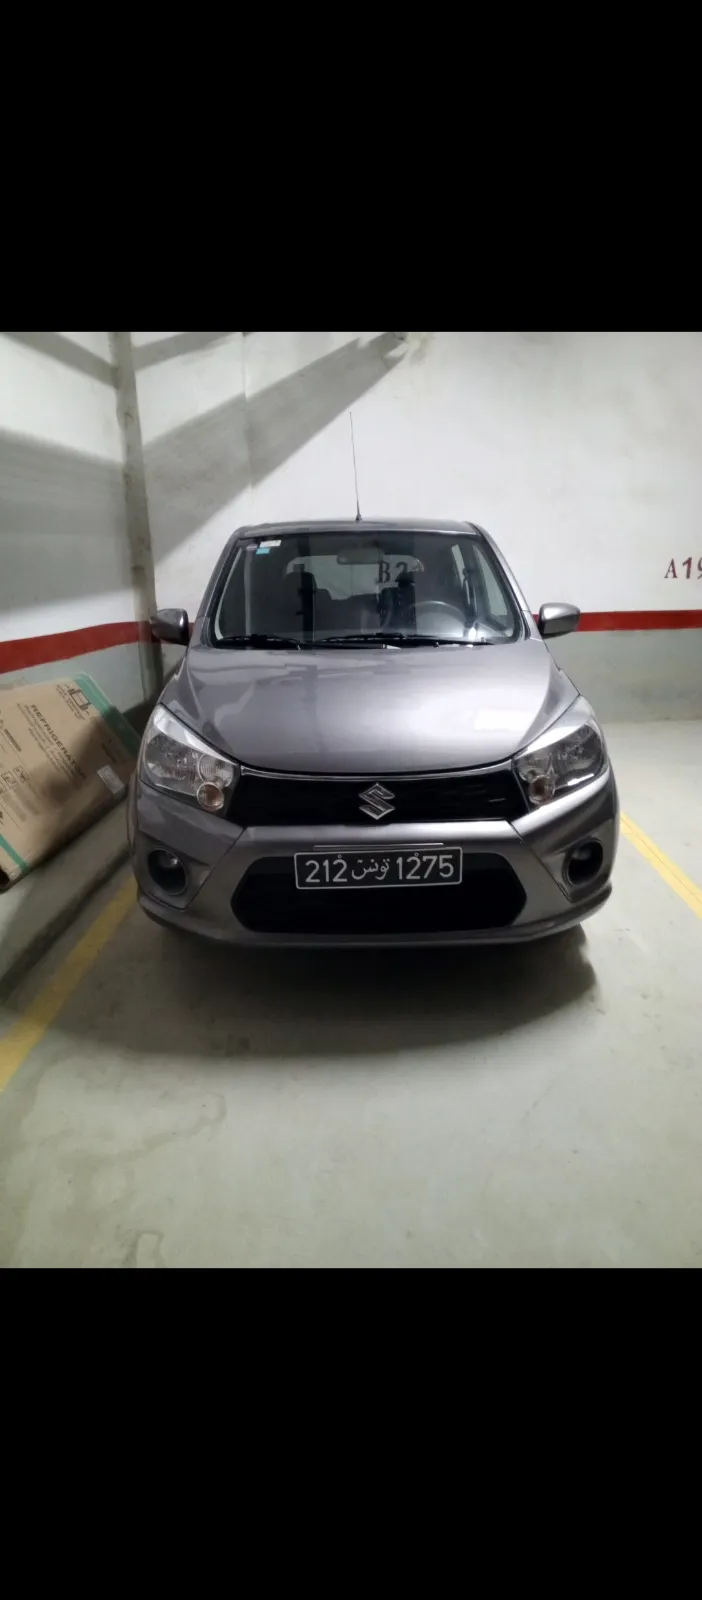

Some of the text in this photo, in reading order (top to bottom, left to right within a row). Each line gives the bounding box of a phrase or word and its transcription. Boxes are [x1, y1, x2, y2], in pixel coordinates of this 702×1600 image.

[305, 854, 455, 883] 212 تونس 1275
